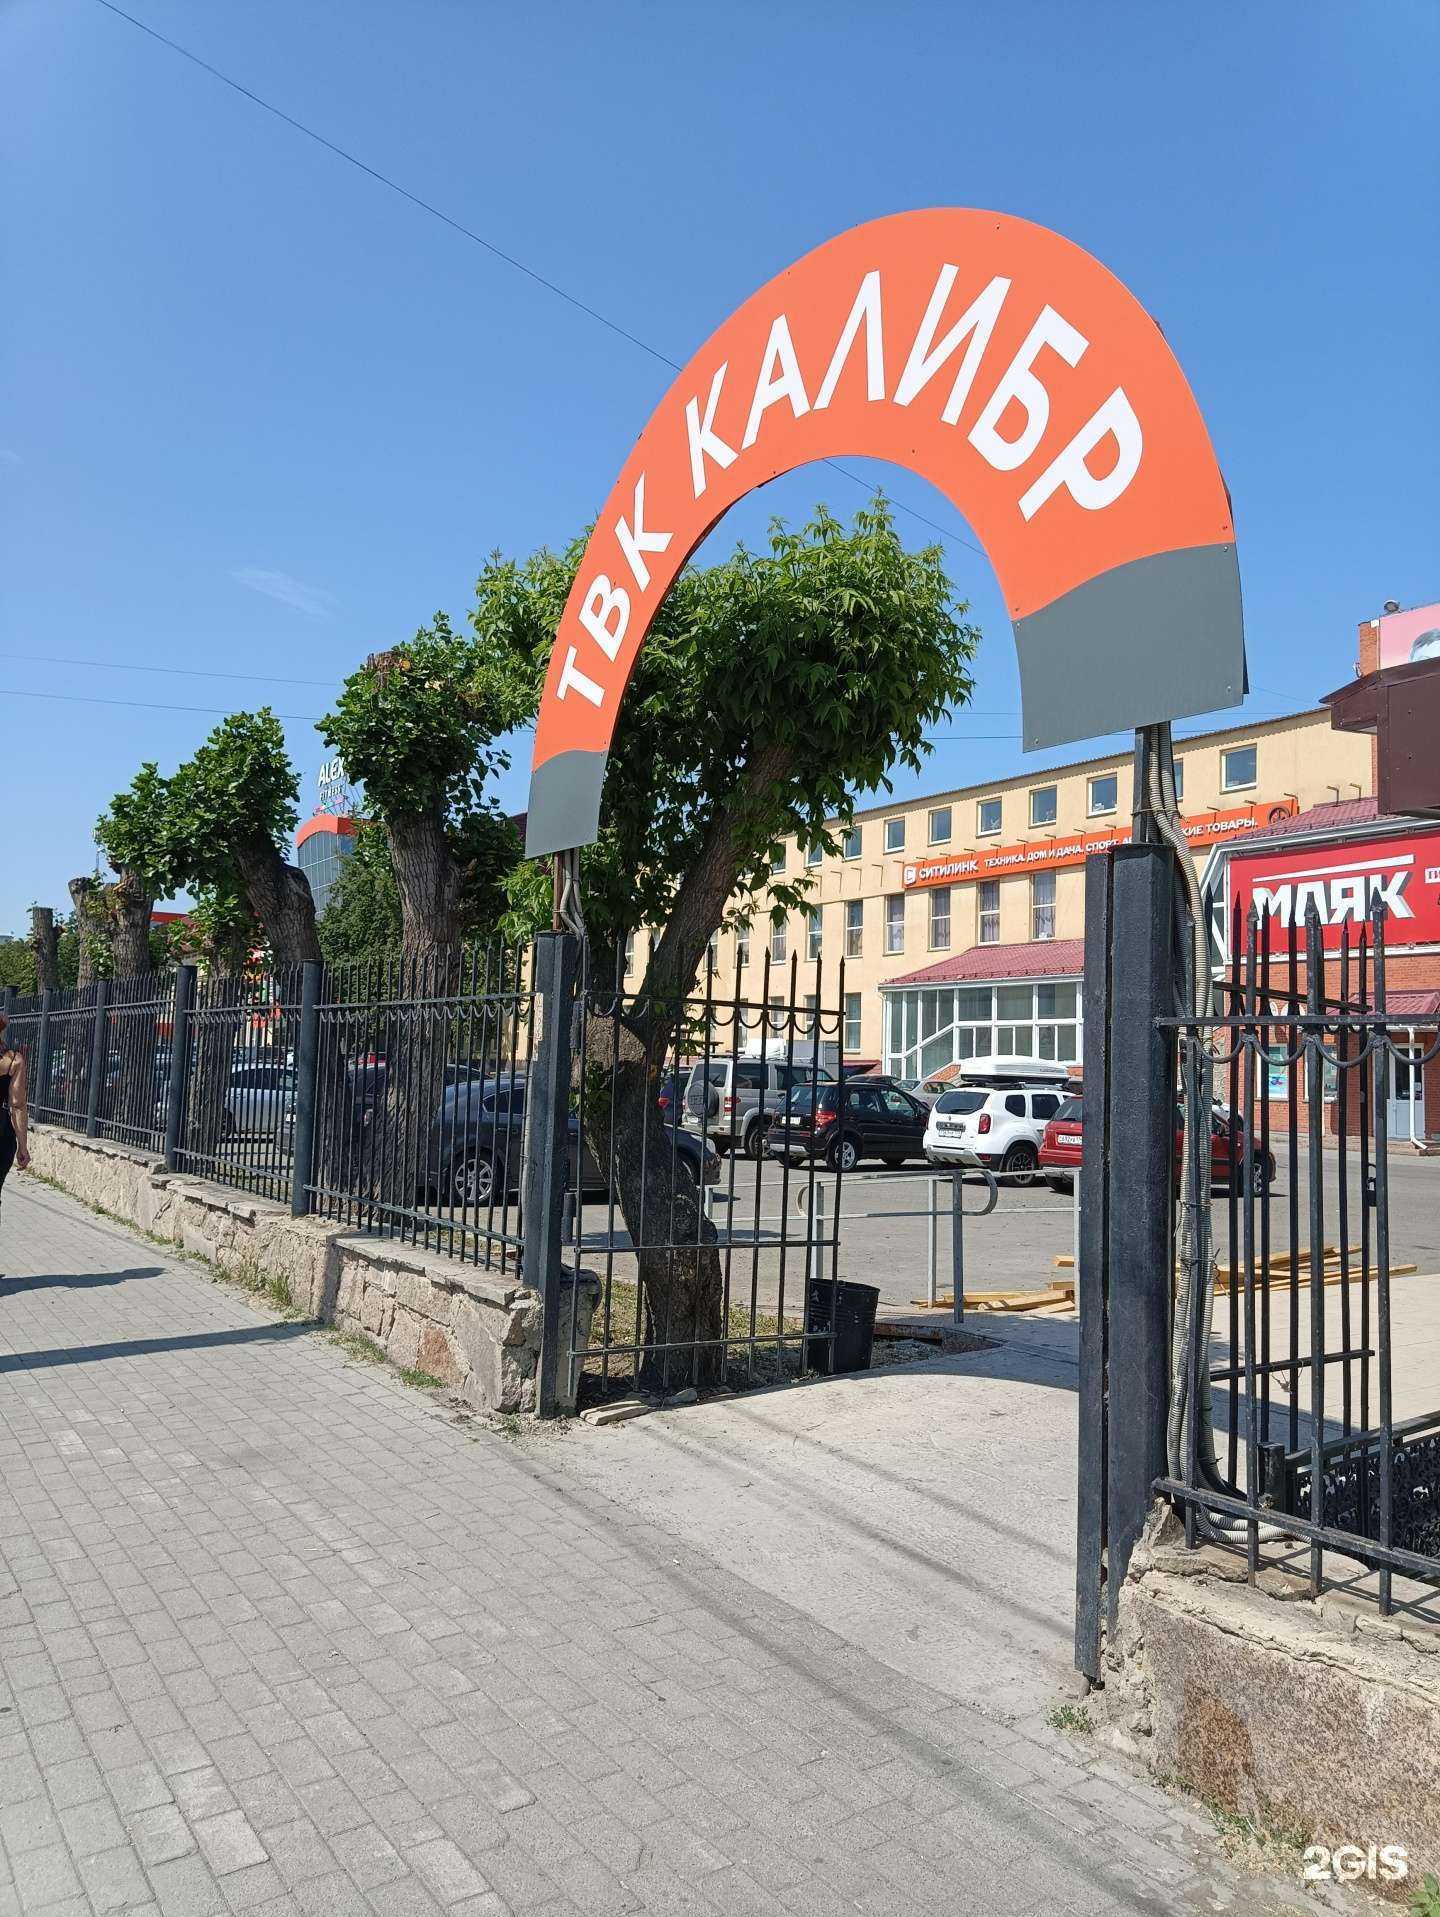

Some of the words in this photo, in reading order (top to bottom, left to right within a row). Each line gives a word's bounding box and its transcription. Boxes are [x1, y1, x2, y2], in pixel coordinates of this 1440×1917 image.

[557, 473, 673, 707] ТВК
[686, 264, 1142, 522] КАЛИБР
[920, 860, 979, 879] СИТИЛИНК
[1027, 850, 1047, 862] ДОМ
[1048, 849, 1055, 858] И
